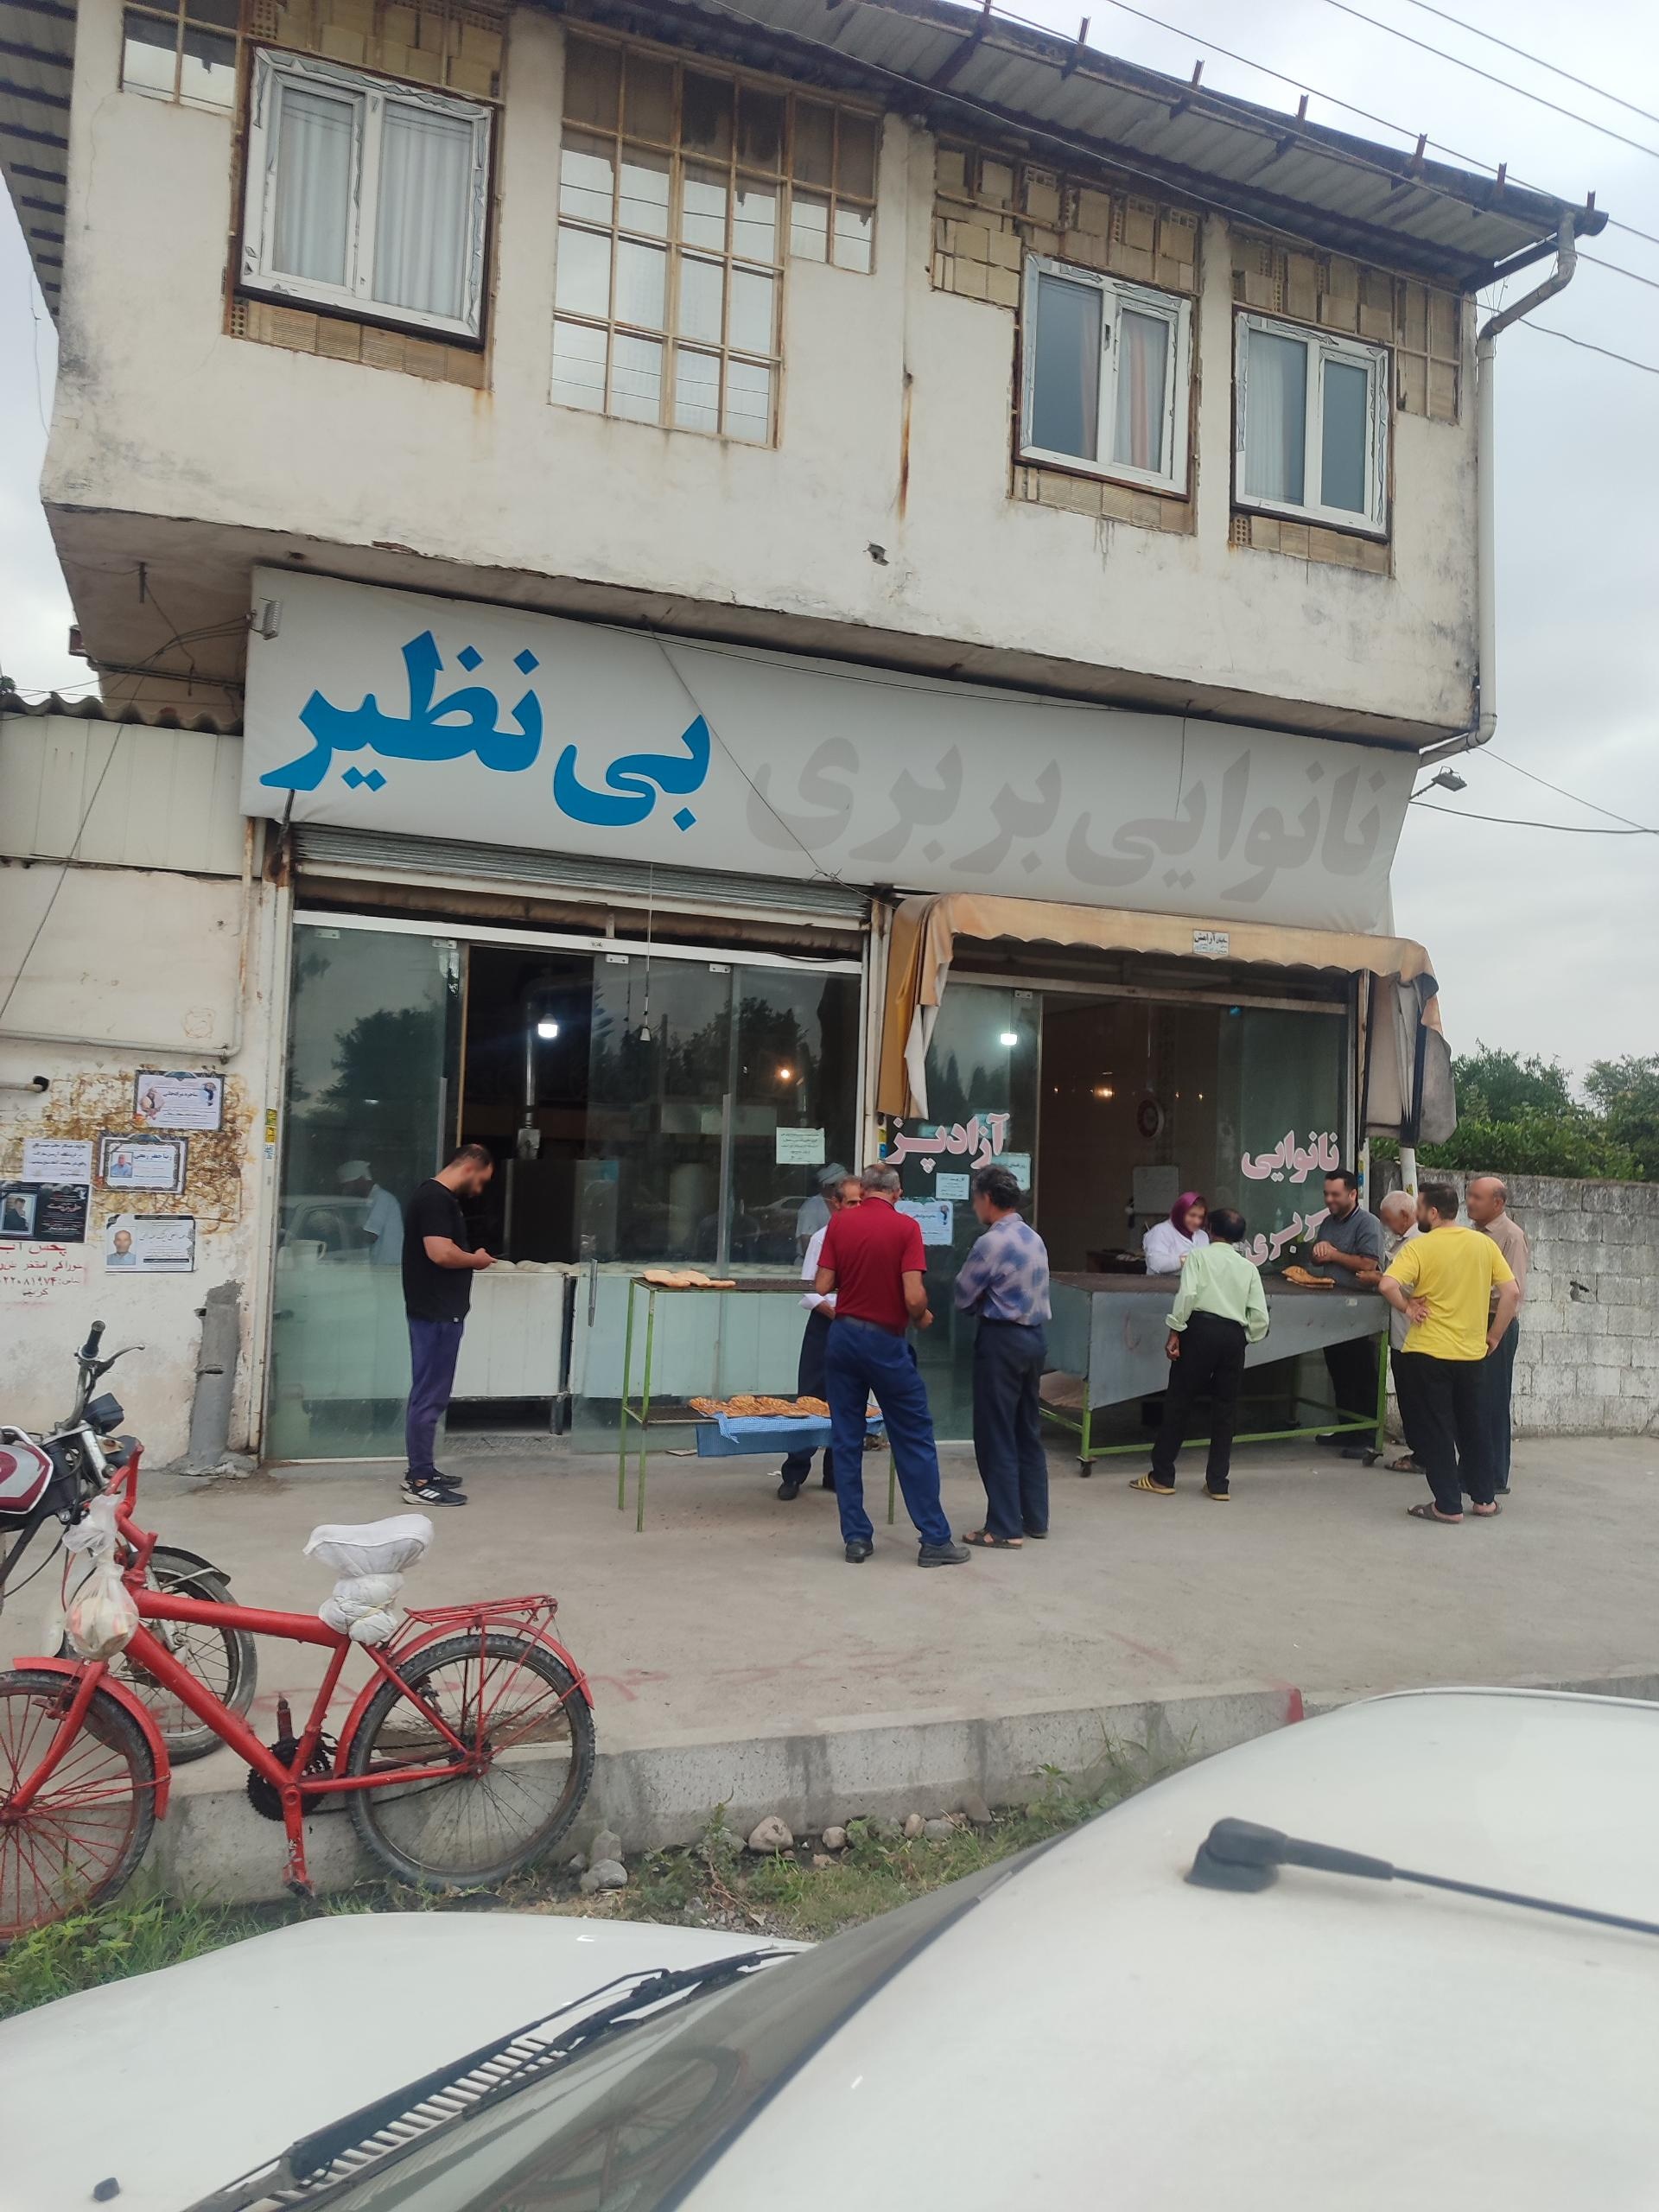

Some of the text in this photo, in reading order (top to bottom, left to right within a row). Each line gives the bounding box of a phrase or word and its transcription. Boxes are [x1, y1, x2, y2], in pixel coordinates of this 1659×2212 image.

[259, 629, 1387, 902] نانوایی بربری بی نظیر
[1241, 1129, 1340, 1184] نانوایی
[1245, 1207, 1332, 1268] ربری
